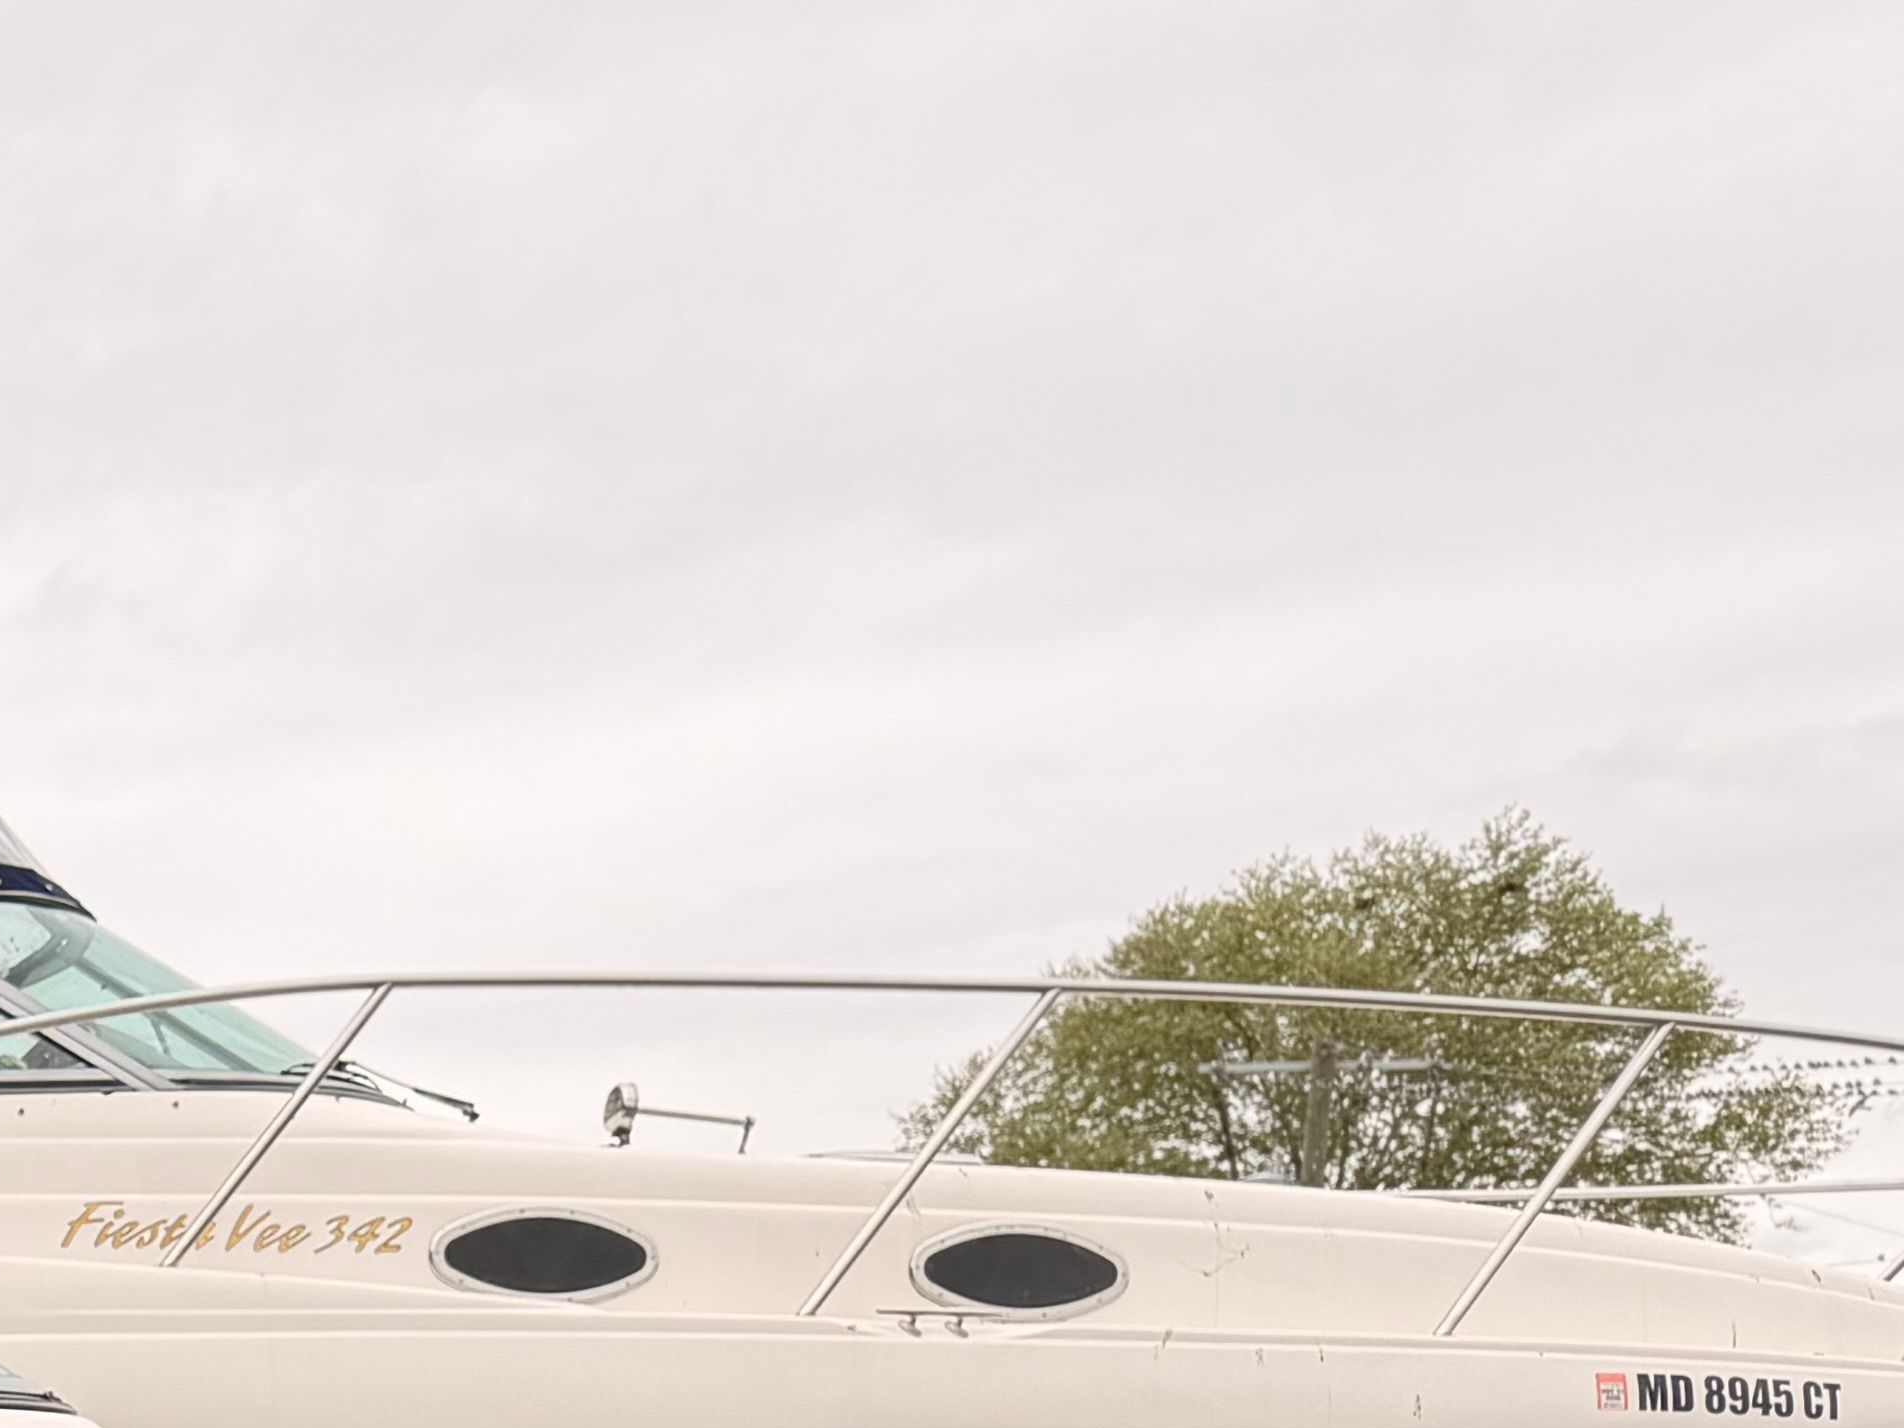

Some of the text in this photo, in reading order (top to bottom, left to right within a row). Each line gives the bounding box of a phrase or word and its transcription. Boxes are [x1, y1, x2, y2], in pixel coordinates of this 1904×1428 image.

[225, 1203, 313, 1254] Vee
[314, 1214, 414, 1256] 342
[1636, 1373, 1694, 1413] MD
[1704, 1375, 1795, 1418] 8945
[1803, 1381, 1842, 1421] CT
